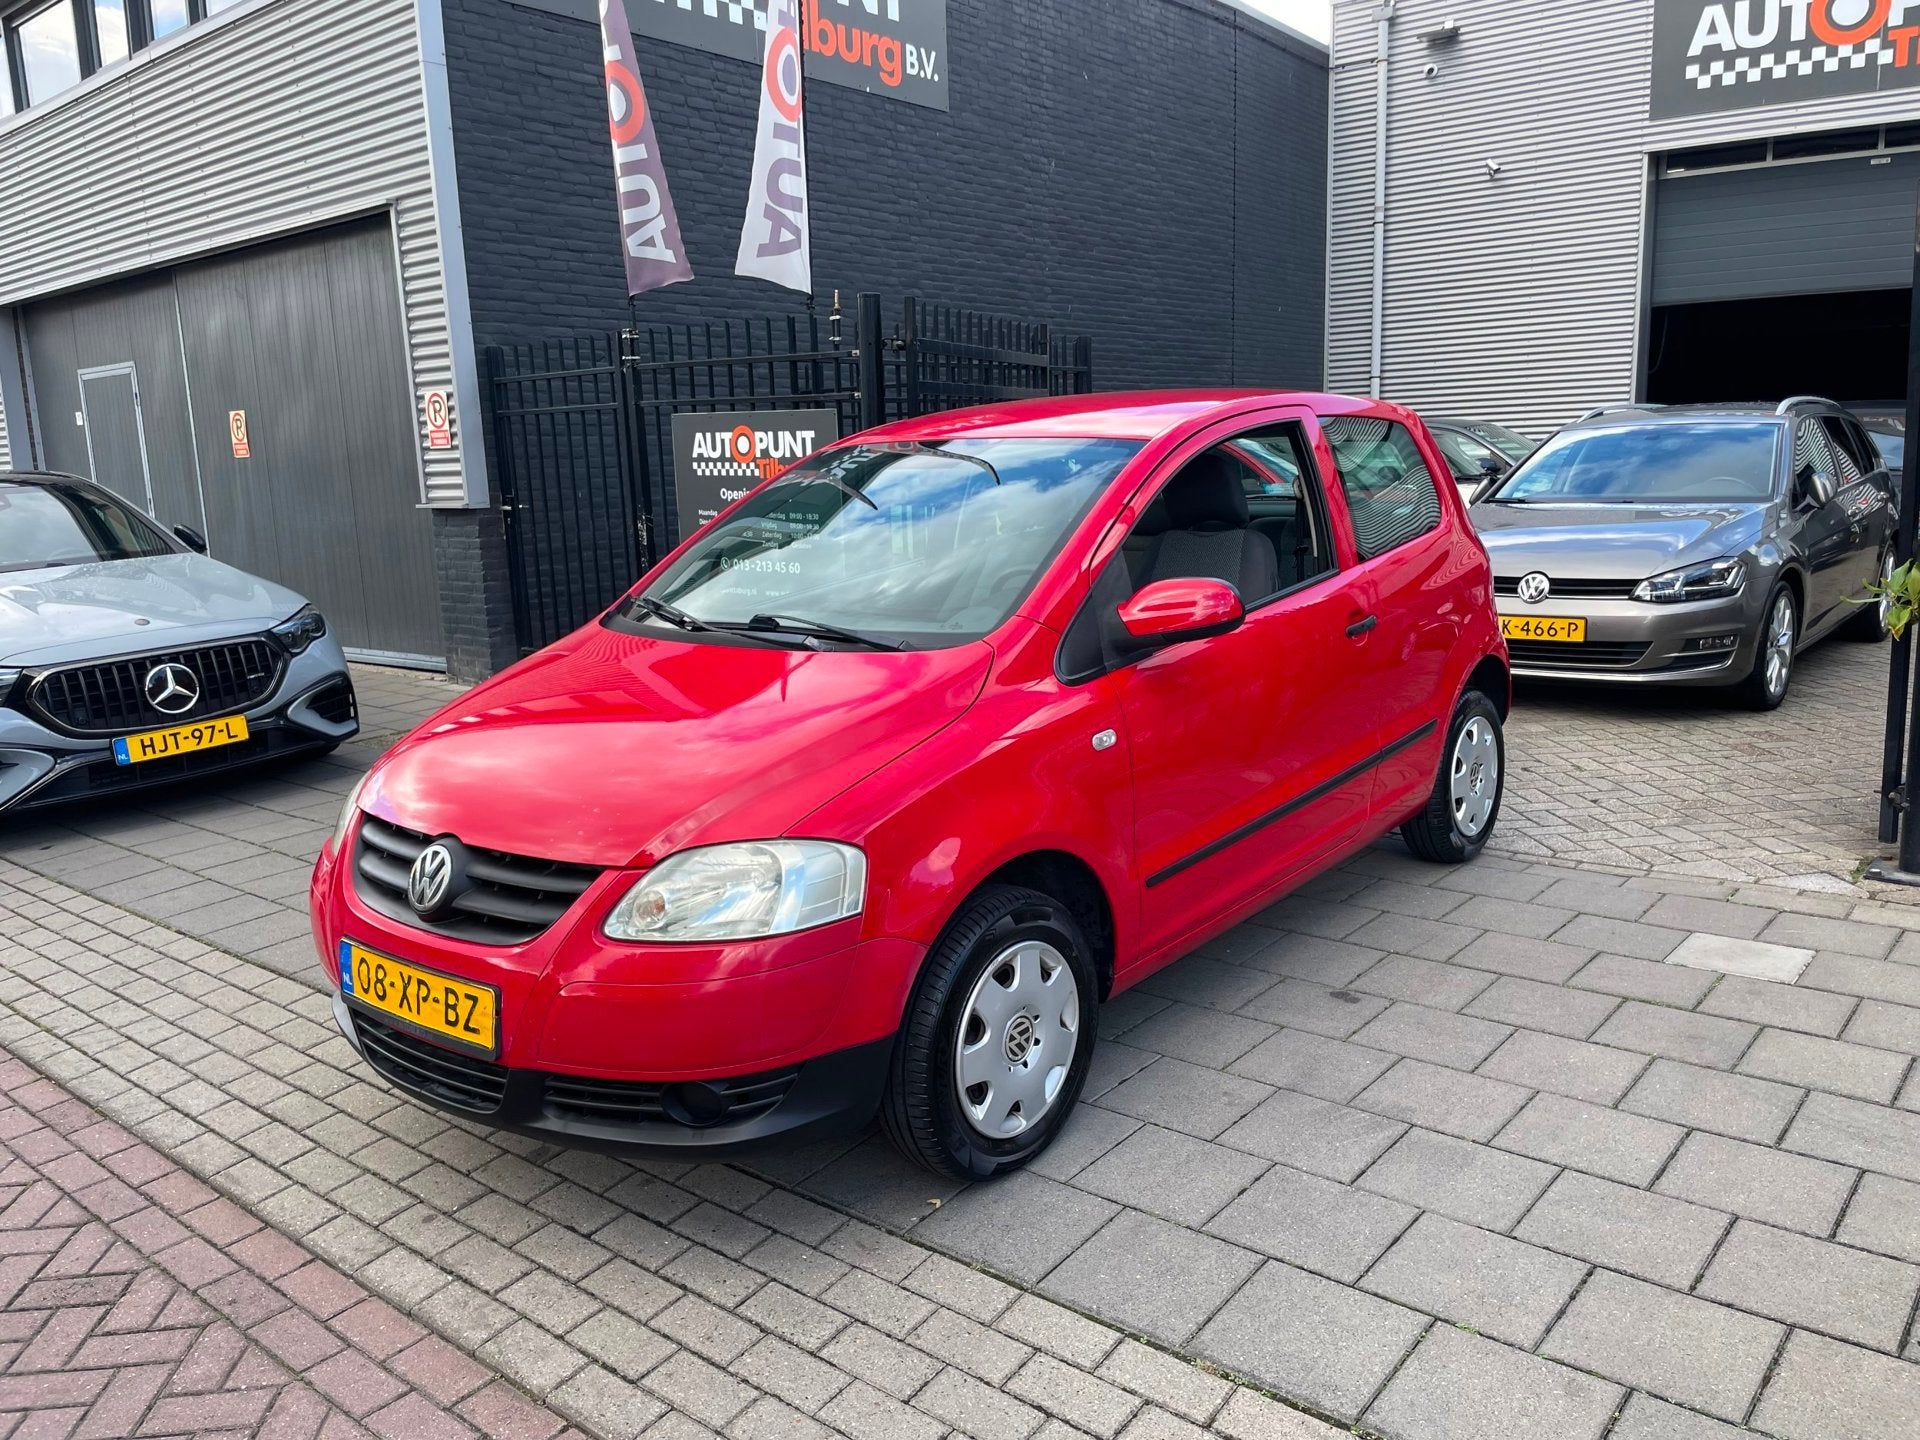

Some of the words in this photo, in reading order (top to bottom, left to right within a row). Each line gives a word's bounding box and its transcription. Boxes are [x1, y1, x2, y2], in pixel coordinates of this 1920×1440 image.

[801, 0, 902, 86] lburg
[905, 45, 939, 83] B.V.
[1887, 25, 1920, 68] T
[692, 425, 816, 464] AUTOPUNT
[757, 457, 788, 480] Tilb
[775, 562, 787, 574] 45
[788, 562, 801, 574] 60
[1501, 619, 1579, 638] K-466-P
[140, 722, 239, 757] HJT-97-L
[357, 956, 481, 1036] 08-XP-BZ
